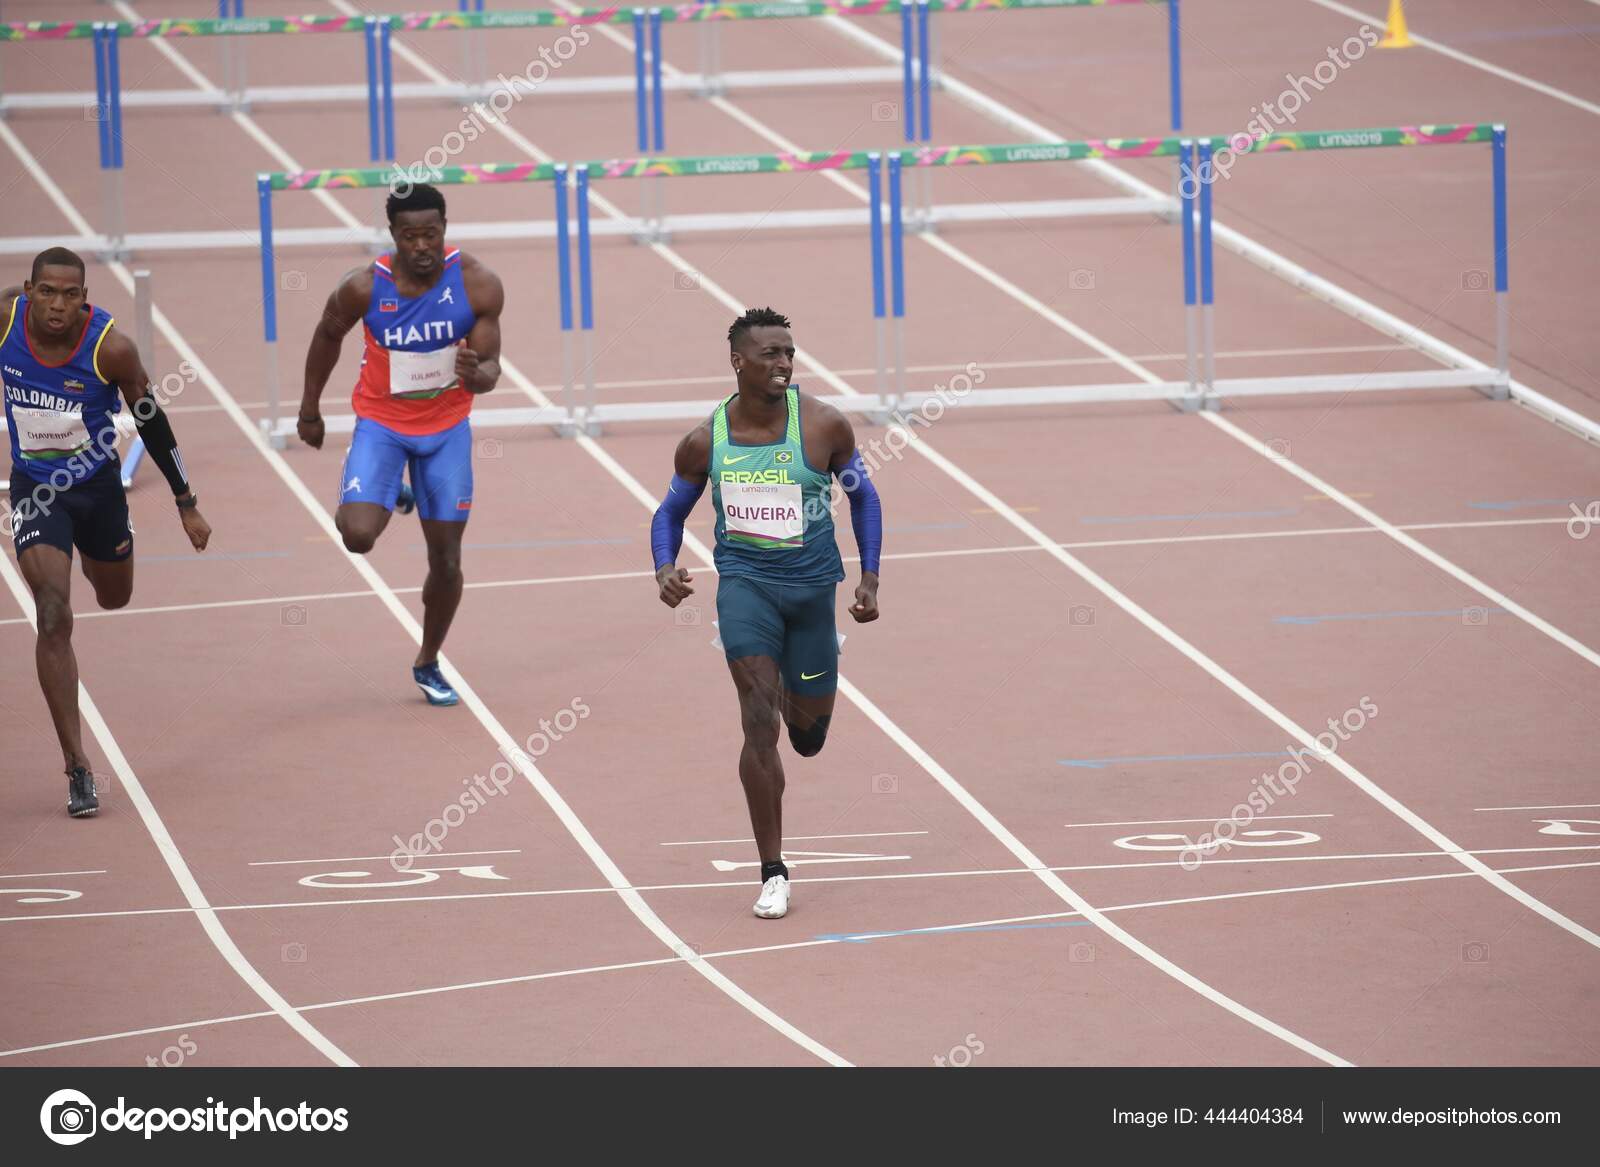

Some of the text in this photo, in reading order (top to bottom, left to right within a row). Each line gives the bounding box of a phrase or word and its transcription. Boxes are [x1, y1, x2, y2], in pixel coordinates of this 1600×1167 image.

[384, 320, 454, 346] HAITI
[5, 384, 83, 414] COLOMBIA
[720, 469, 796, 485] BRASIL
[727, 504, 797, 521] OLIVEIRA
